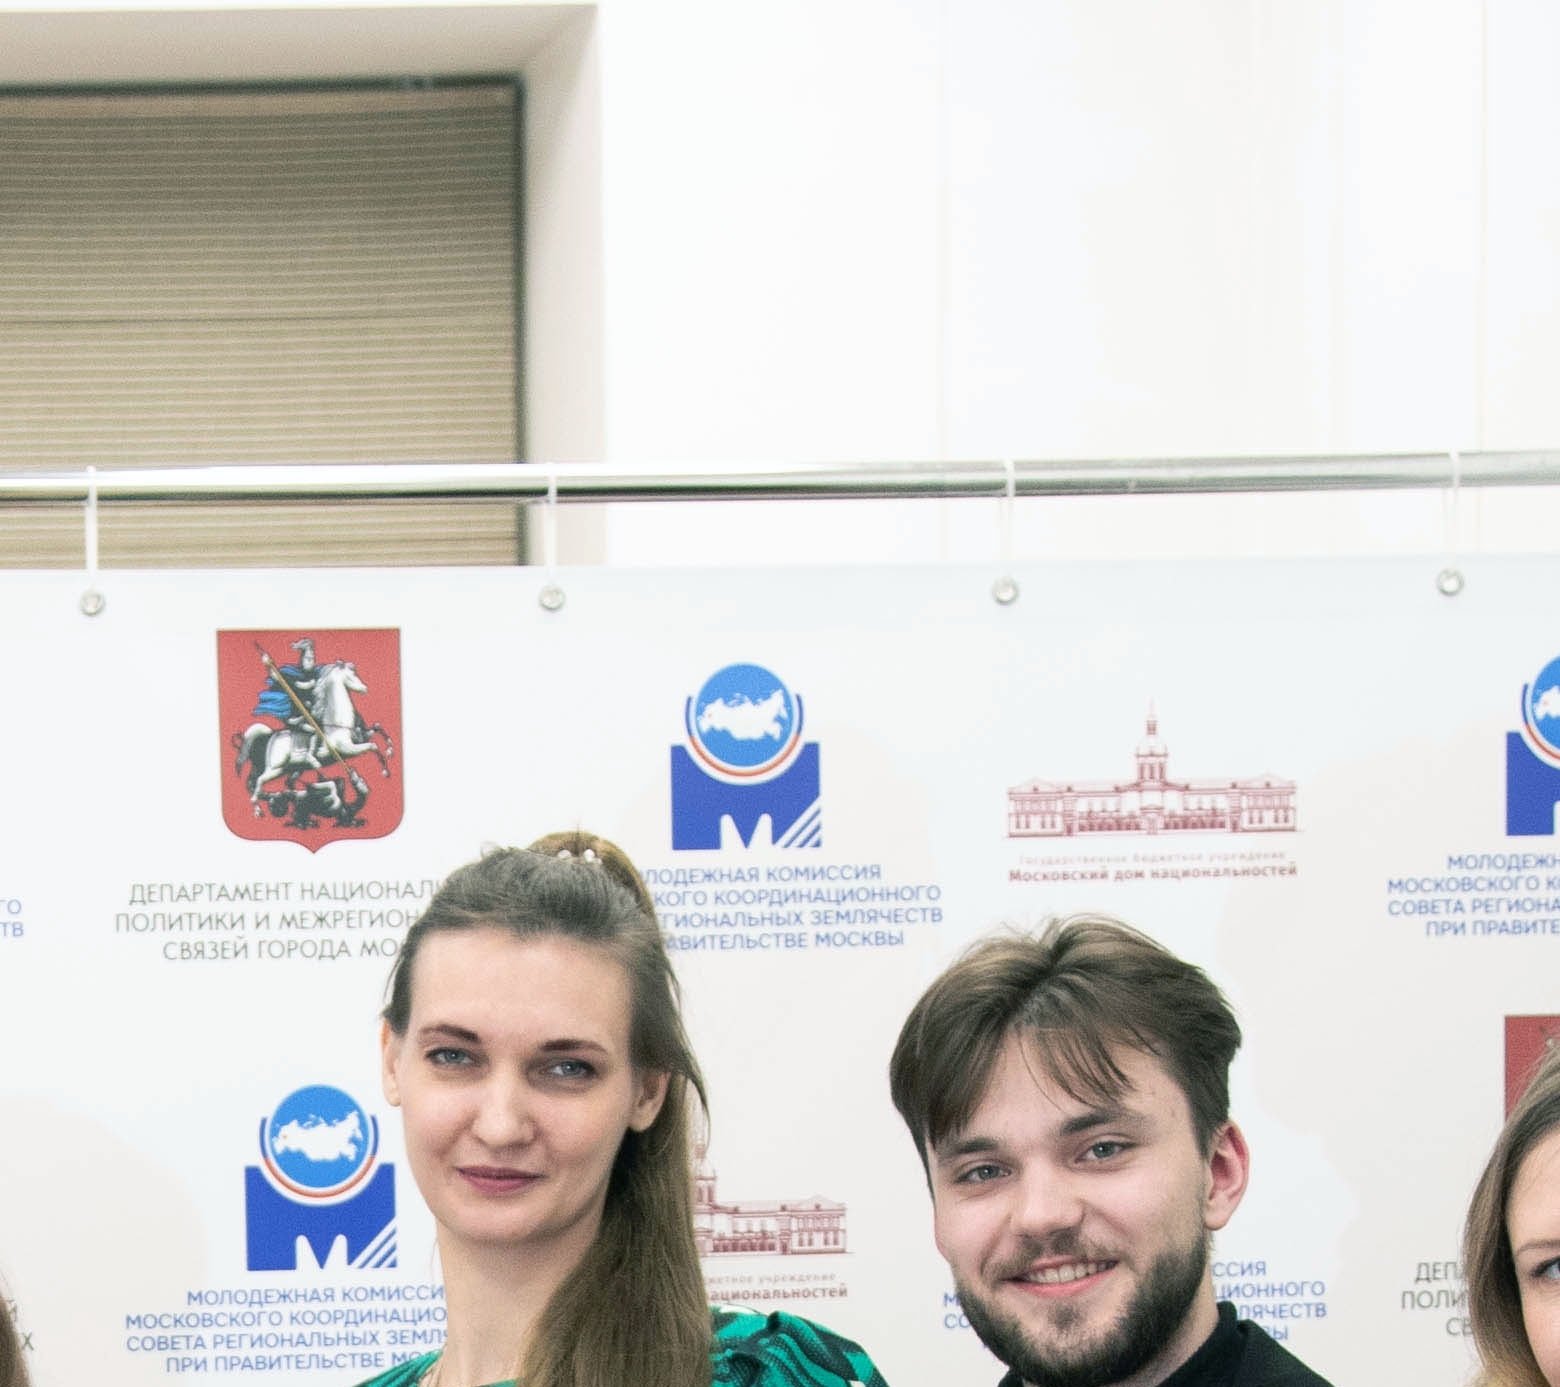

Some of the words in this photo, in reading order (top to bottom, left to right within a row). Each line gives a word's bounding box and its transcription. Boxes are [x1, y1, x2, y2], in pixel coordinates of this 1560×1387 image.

[765, 863, 882, 883] КОМИССИЯ
[1008, 865, 1110, 883] Московский
[1113, 869, 1146, 882] дом
[1150, 858, 1298, 881] национальностей
[128, 881, 293, 906] ДЕПАРТАМЕНТ
[1386, 874, 1541, 895] МОСКОВСКОГО
[713, 884, 942, 909] КООРДИНАЦИОННОГО
[1387, 897, 1467, 917] СОВЕТА
[115, 912, 246, 933] ПОЛИТИКИ
[254, 912, 270, 931] И
[810, 906, 944, 927] ЗЕМЛЯЧЕСТВ
[1425, 919, 1467, 937] ПРИ
[162, 935, 249, 961] СВЯЗЕЙ
[257, 938, 353, 961] ГОРОДА
[814, 930, 905, 948] МОСКВЫ
[187, 1287, 336, 1309] МОЛОДЕЖНАЯ
[125, 1310, 284, 1330] МОСКОВСКОГО
[126, 1334, 208, 1353] СОВЕТА
[212, 1330, 381, 1350] РЕГИОНАЛЬНЫХ
[165, 1356, 208, 1373] ПРИ
[214, 1351, 391, 1372] ПРАВИТЕЛЬСТВЕ
